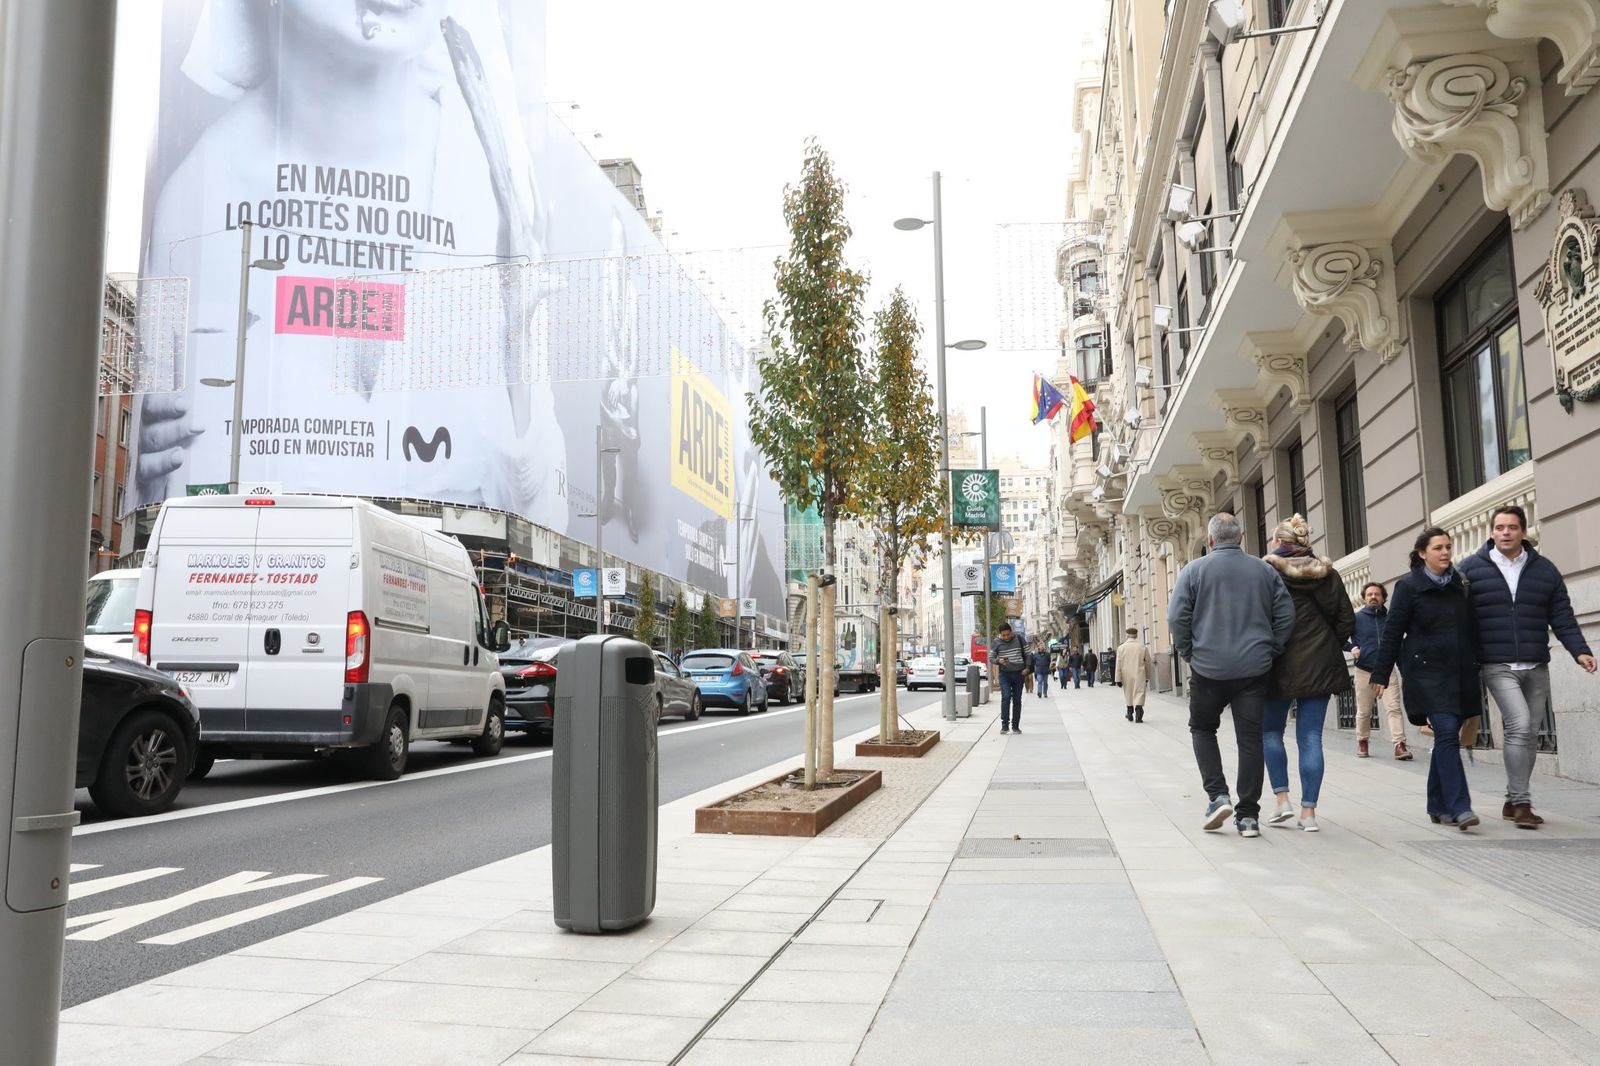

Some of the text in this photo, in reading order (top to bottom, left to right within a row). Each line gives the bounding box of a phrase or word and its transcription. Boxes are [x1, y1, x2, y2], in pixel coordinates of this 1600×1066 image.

[277, 163, 410, 203] EN MADRID
[226, 196, 456, 249] LO CORTÉS NO QUITA
[287, 285, 379, 332] ARDE
[224, 418, 375, 437] TMPORADA COMPLETA
[679, 380, 724, 494] ARDE
[250, 438, 375, 458] SOLO EN MOVISTAR
[187, 553, 326, 568] MARMOLES Y GRANITOS
[233, 601, 249, 609] 678
[250, 601, 266, 609] 623
[268, 601, 284, 609] 275
[212, 613, 233, 621] Corral
[234, 613, 243, 621] de
[281, 613, 309, 623] (Toledo)
[175, 672, 227, 683] 4527 JWX
